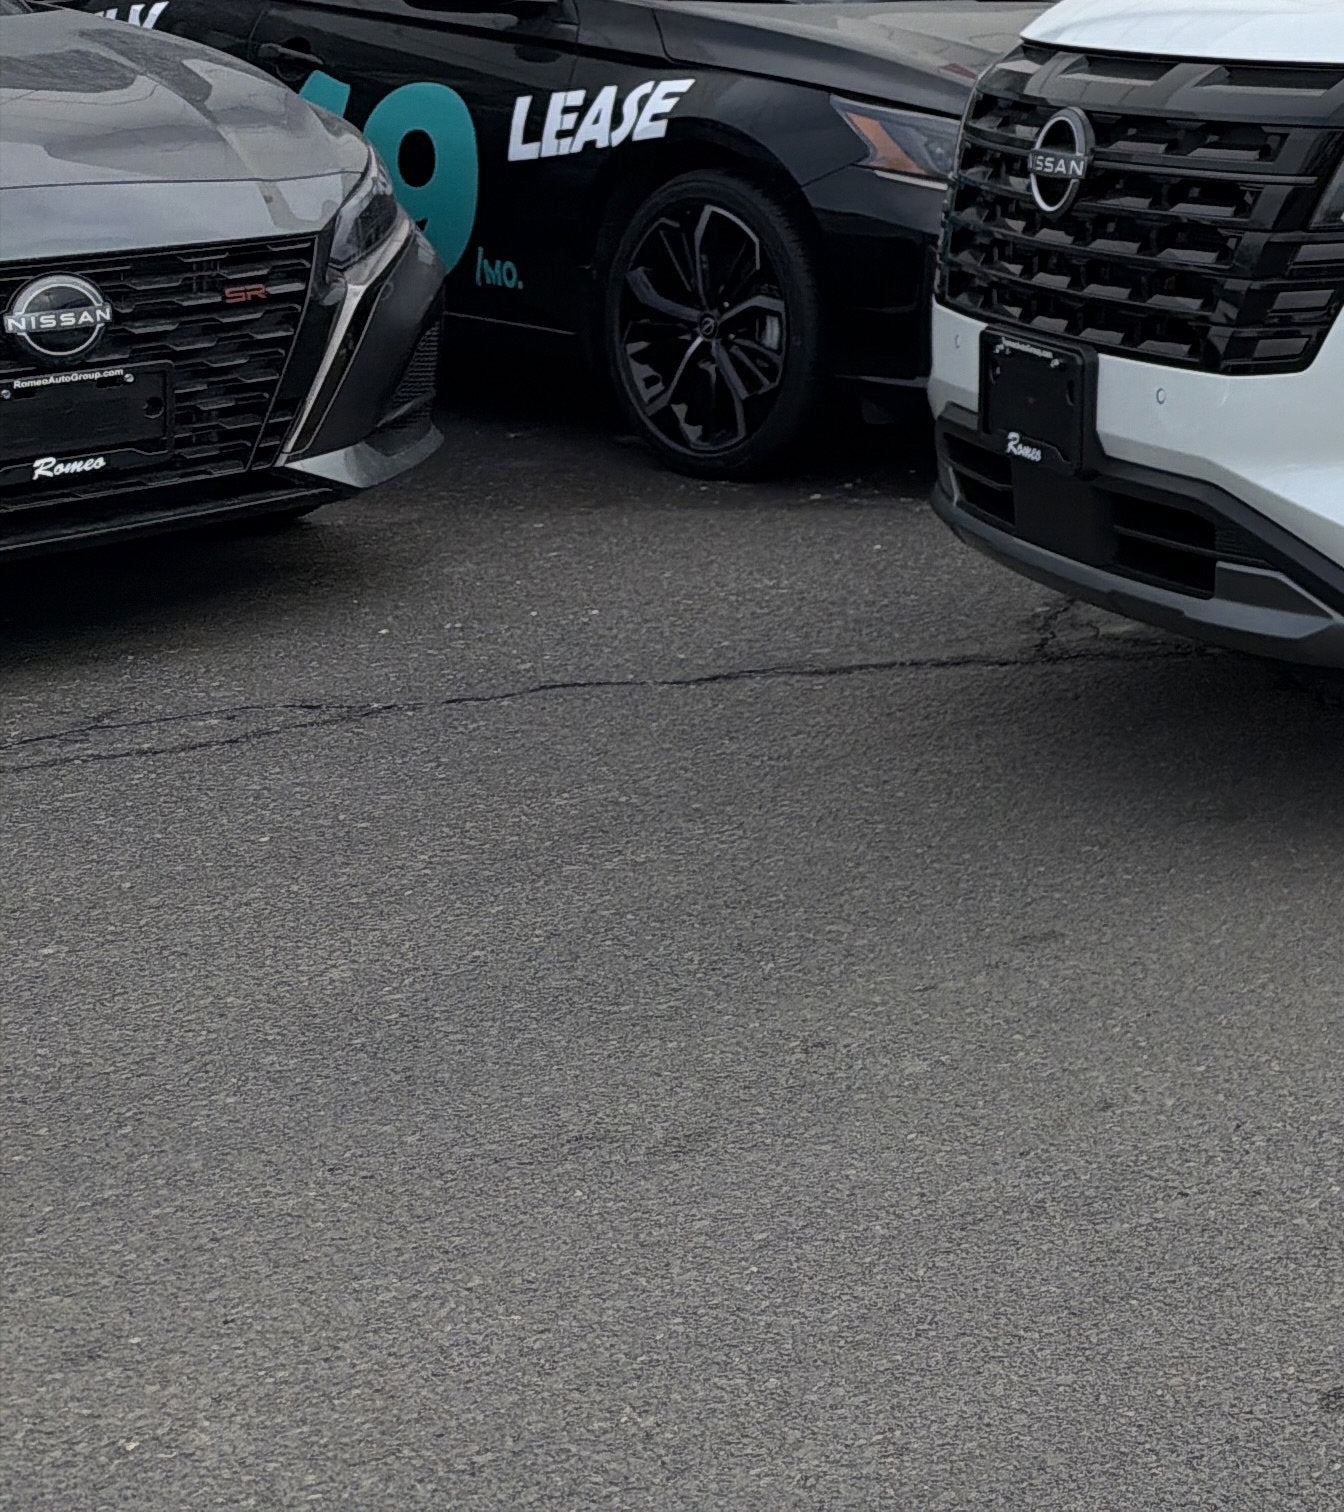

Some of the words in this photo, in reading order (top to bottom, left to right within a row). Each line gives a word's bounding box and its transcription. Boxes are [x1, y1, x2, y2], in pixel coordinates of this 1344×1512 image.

[507, 79, 696, 162] LEASE
[475, 246, 523, 289] /MO.
[224, 283, 268, 303] SR
[7, 307, 112, 333] NISSAN
[13, 369, 124, 389] RomeoAutoGroup.com
[32, 456, 107, 480] Romeo
